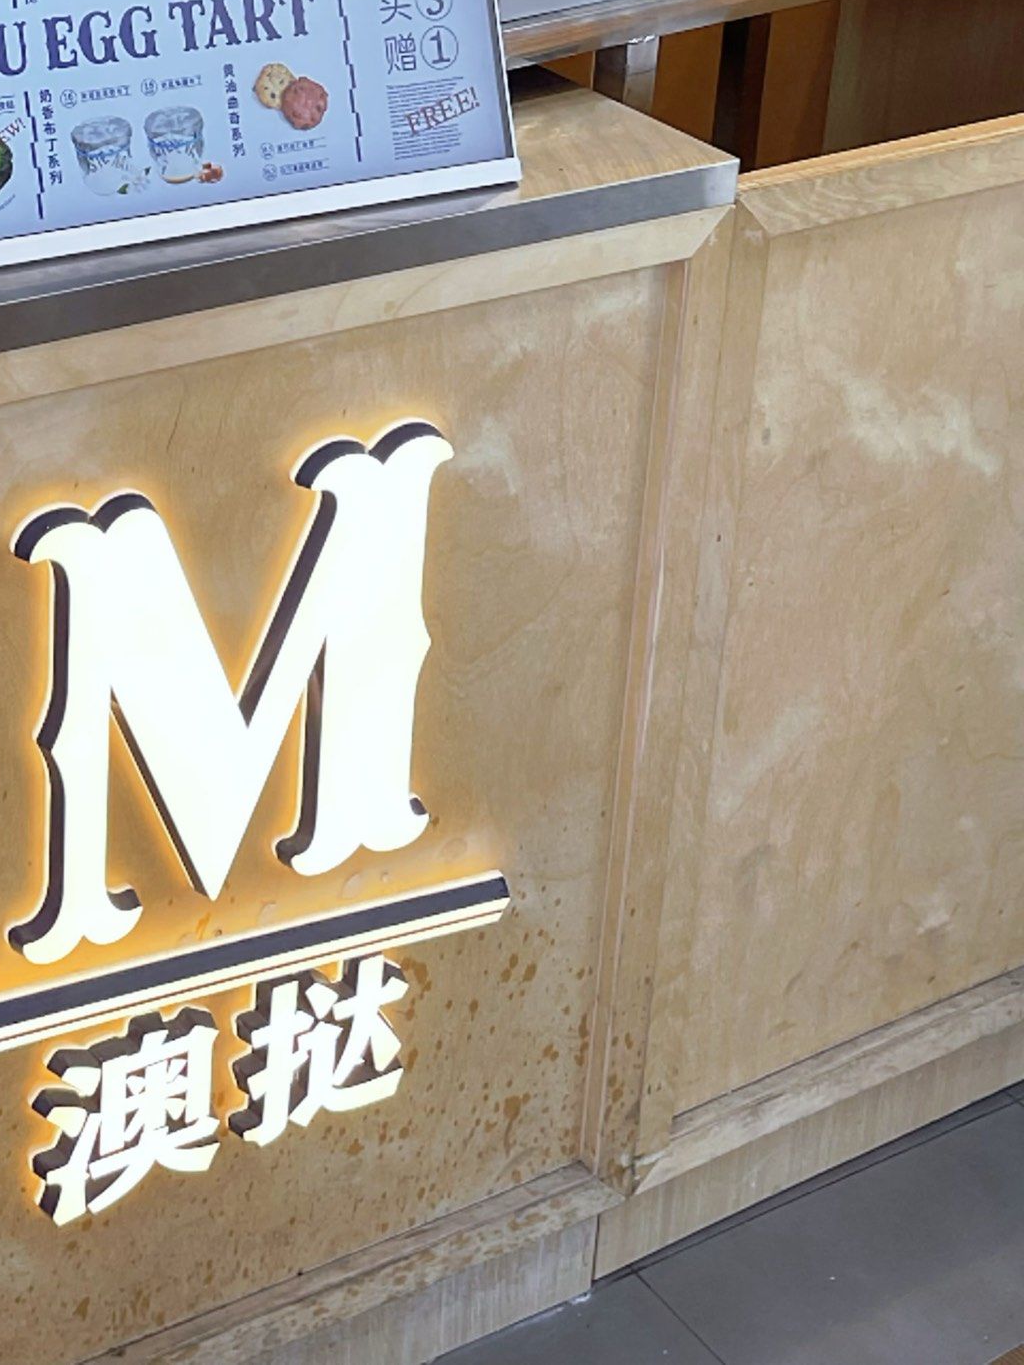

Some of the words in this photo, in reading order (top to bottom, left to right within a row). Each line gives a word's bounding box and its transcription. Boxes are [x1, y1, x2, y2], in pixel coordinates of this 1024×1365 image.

[44, 4, 159, 71] EGG
[384, 32, 416, 75] 赠
[39, 89, 63, 185] 奶香布丁系列
[223, 63, 245, 157] 黄油曲奇系列
[406, 86, 480, 136] FREE!
[6, 417, 454, 965] M
[31, 955, 407, 1226] 澳挞
